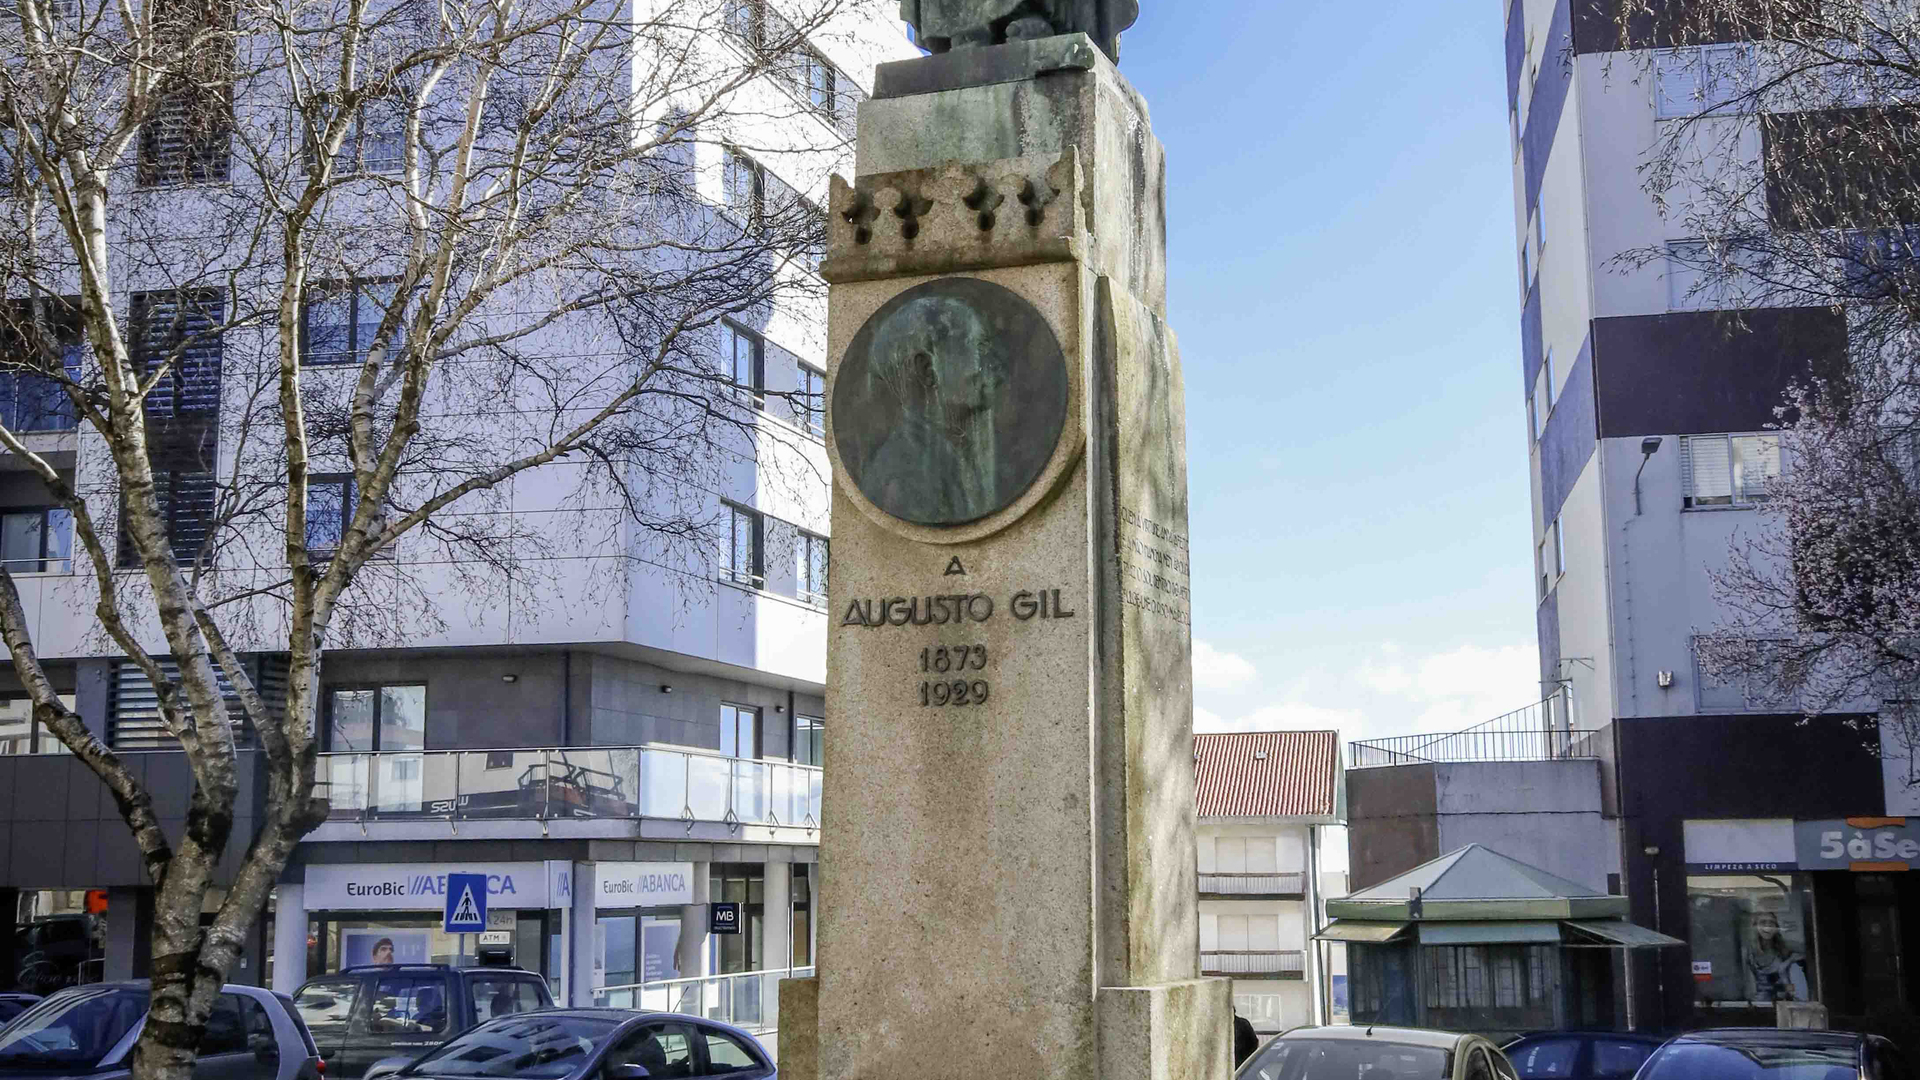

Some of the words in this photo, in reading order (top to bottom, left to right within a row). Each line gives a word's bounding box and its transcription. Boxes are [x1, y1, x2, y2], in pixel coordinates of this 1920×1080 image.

[943, 555, 966, 576] A
[841, 592, 994, 627] AUGUSTO
[1009, 588, 1075, 621] GIL
[919, 643, 988, 673] 1873
[919, 679, 990, 707] 1929
[346, 882, 405, 896] EuroBic
[603, 880, 634, 894] EuroBic
[716, 910, 735, 921] MB
[482, 934, 500, 942] ATM
